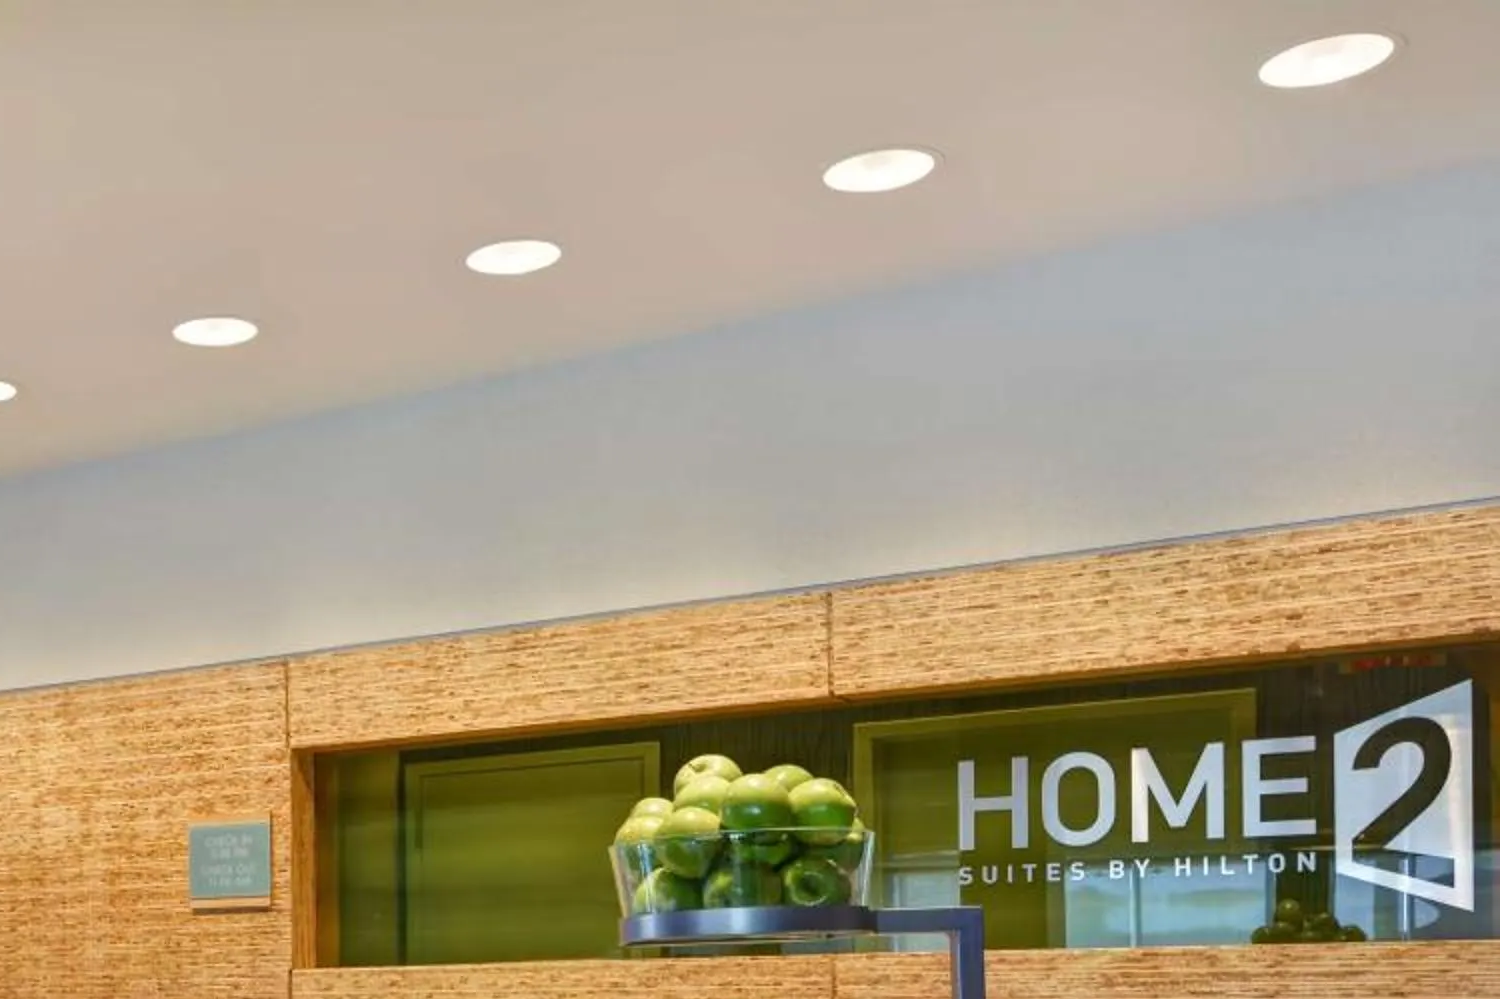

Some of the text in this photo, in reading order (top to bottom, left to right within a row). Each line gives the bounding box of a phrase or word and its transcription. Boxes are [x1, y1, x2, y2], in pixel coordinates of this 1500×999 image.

[957, 715, 1456, 889] HOME 2
[958, 852, 1318, 885] SUITES BY HILTON
